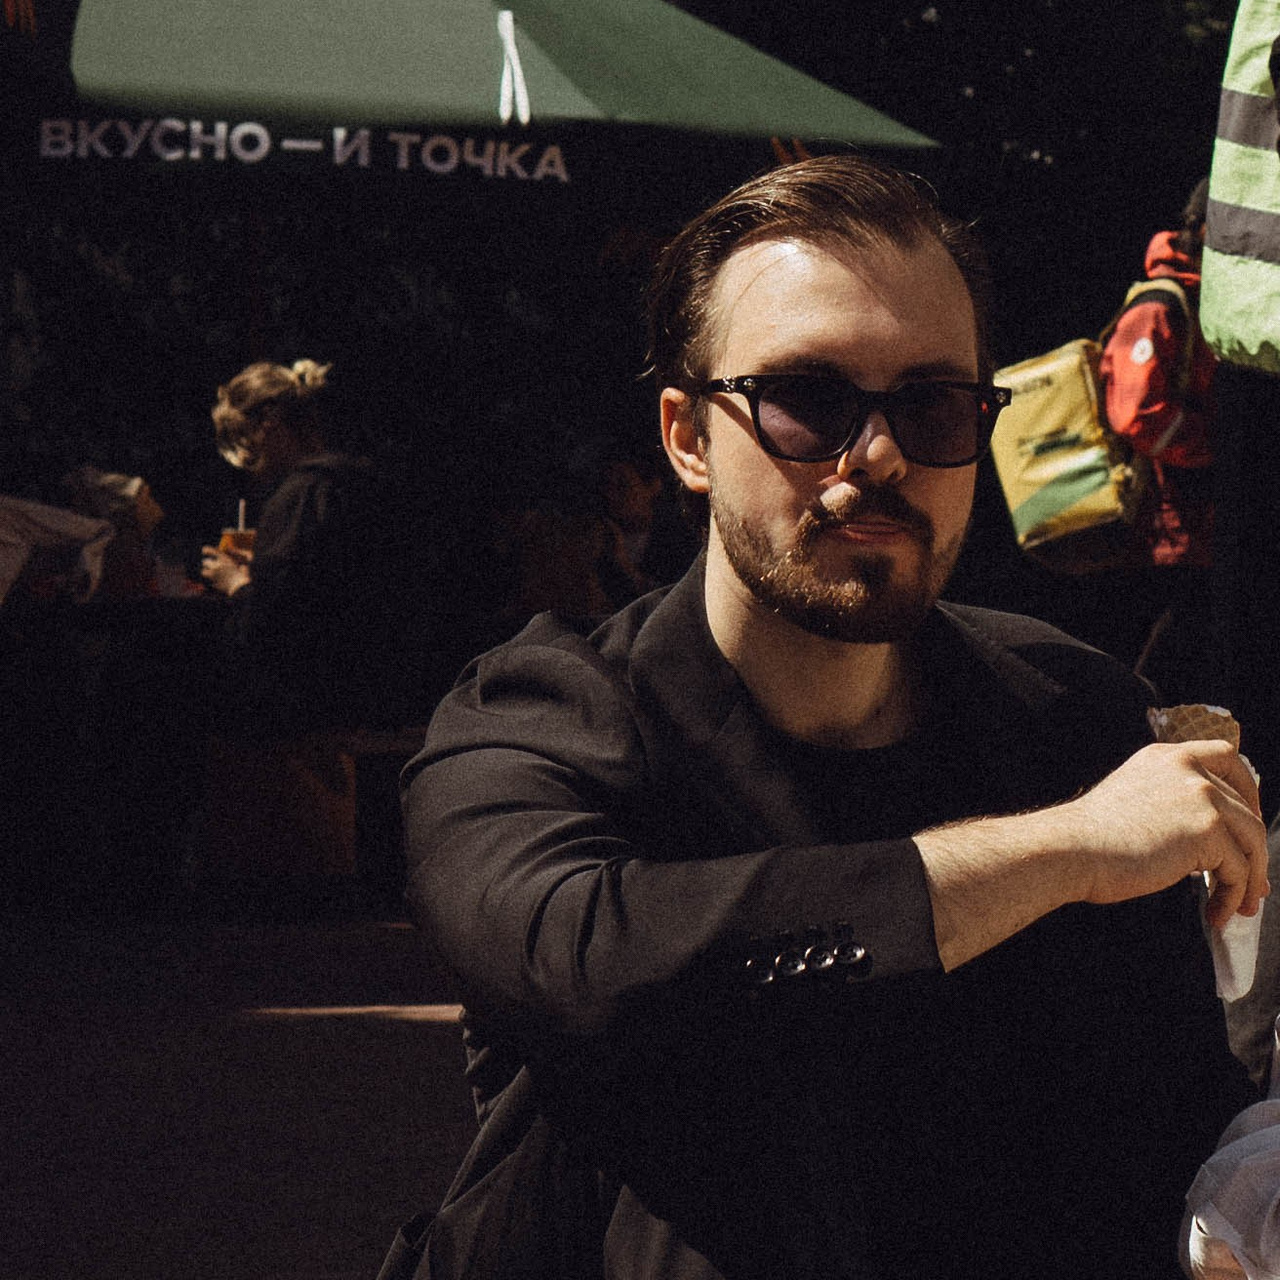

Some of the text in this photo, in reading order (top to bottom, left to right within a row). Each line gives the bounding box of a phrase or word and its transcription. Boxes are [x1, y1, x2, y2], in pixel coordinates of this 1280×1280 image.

[39, 118, 271, 163] ВКУСНО
[333, 127, 370, 168] И
[389, 131, 569, 182] ТОЧКА
